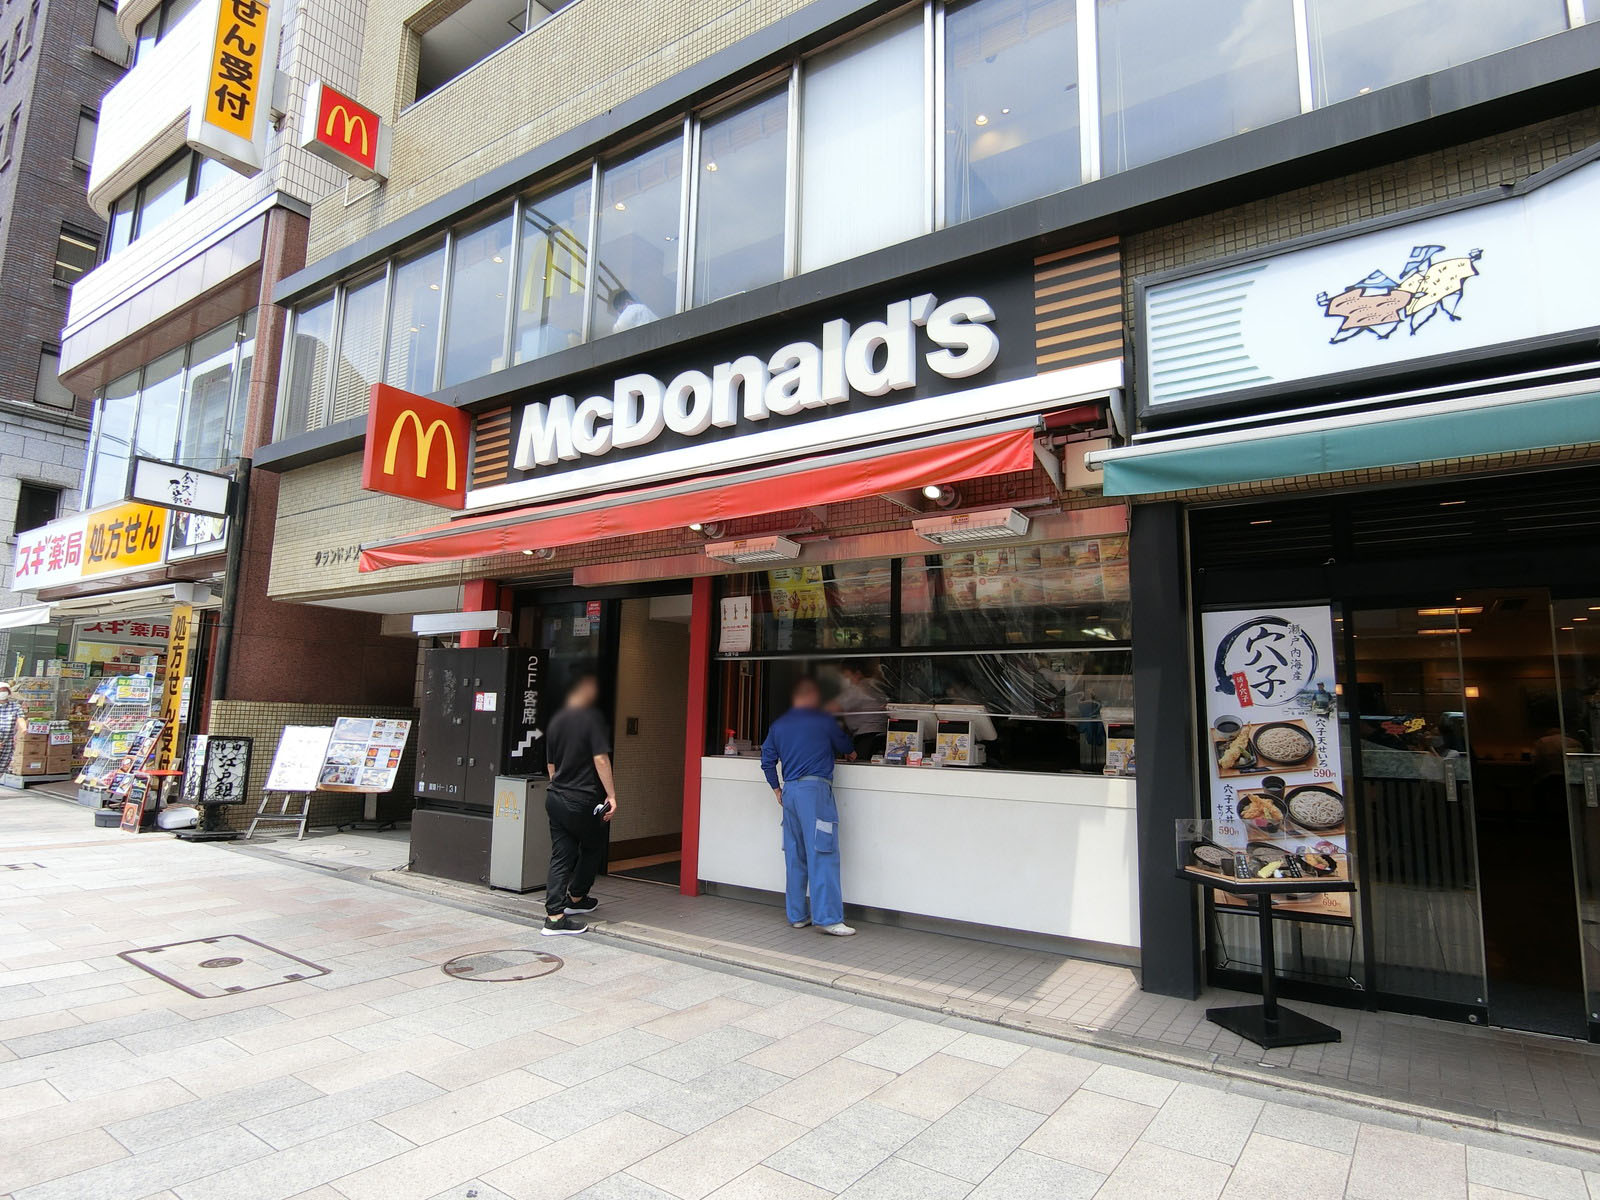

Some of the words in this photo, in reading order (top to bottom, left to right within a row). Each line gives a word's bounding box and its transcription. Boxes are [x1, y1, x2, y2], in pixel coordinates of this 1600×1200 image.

[214, 0, 262, 121] せん受付
[514, 293, 999, 471] McDonald's
[16, 530, 83, 577] スギ薬局
[88, 510, 160, 564] 処方せん
[1245, 626, 1288, 699] 穴子
[1288, 624, 1303, 681] 瀬戸内海産
[1315, 719, 1328, 767] 穴子天せいろ
